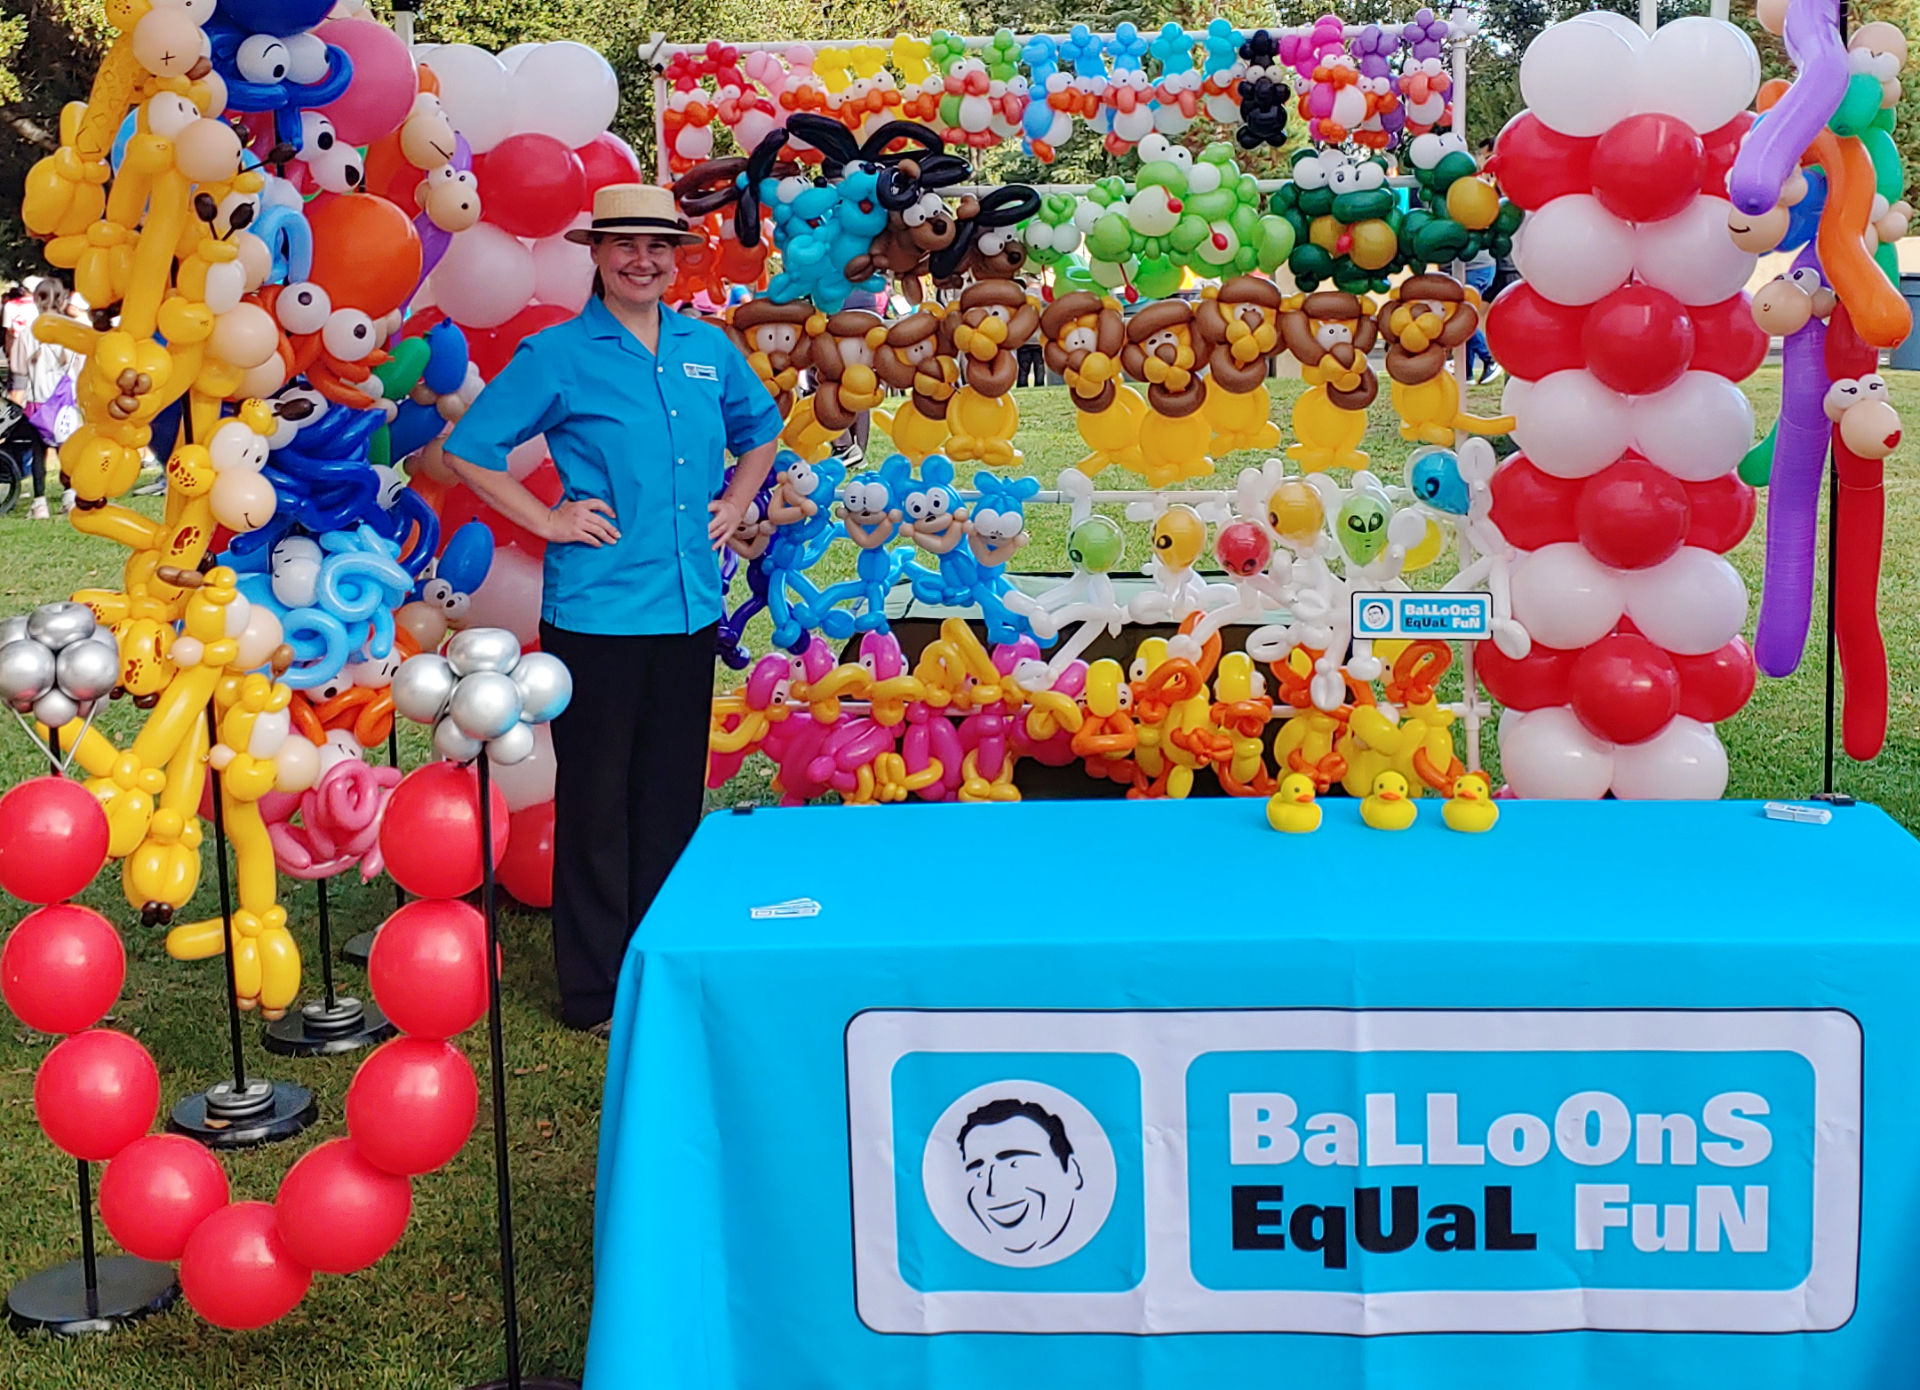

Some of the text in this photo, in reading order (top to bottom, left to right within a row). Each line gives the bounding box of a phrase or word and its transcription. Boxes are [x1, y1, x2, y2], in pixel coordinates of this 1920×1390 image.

[1405, 604, 1481, 616] BaLLoOnS
[1405, 617, 1481, 629] EqUaL FuN
[1228, 1090, 1773, 1167] BaLLoOnS
[1231, 1184, 1770, 1270] EqUaL FuN
